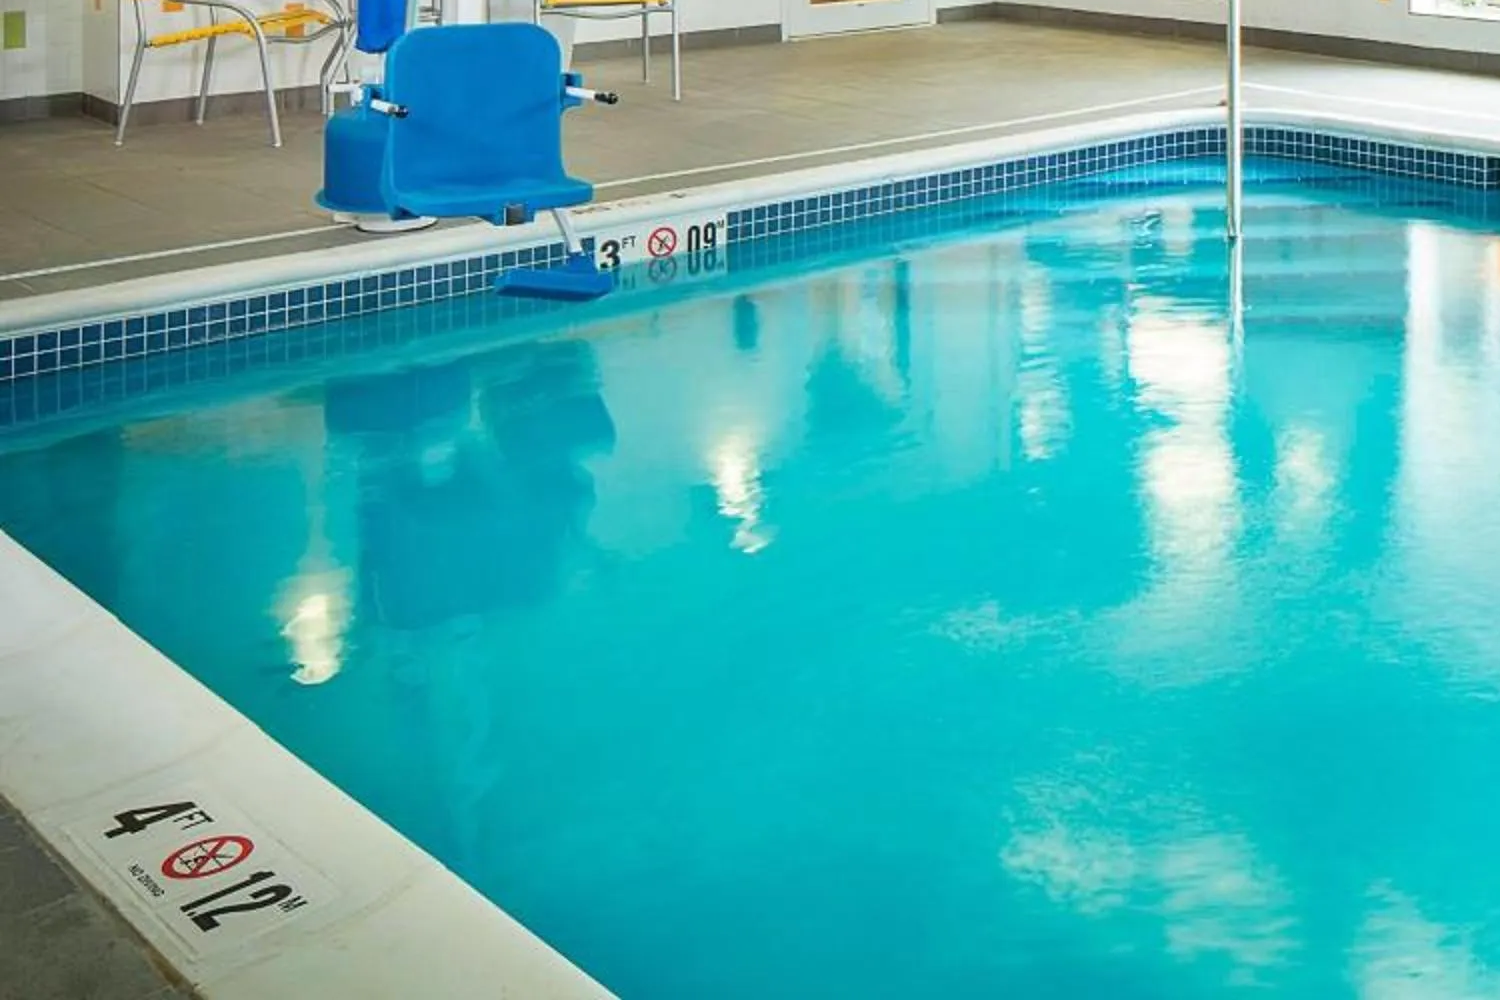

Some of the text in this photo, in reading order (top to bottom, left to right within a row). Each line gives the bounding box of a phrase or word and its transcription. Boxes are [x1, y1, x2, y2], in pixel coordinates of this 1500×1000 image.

[600, 239, 621, 269] 3
[104, 801, 215, 839] 4 FT
